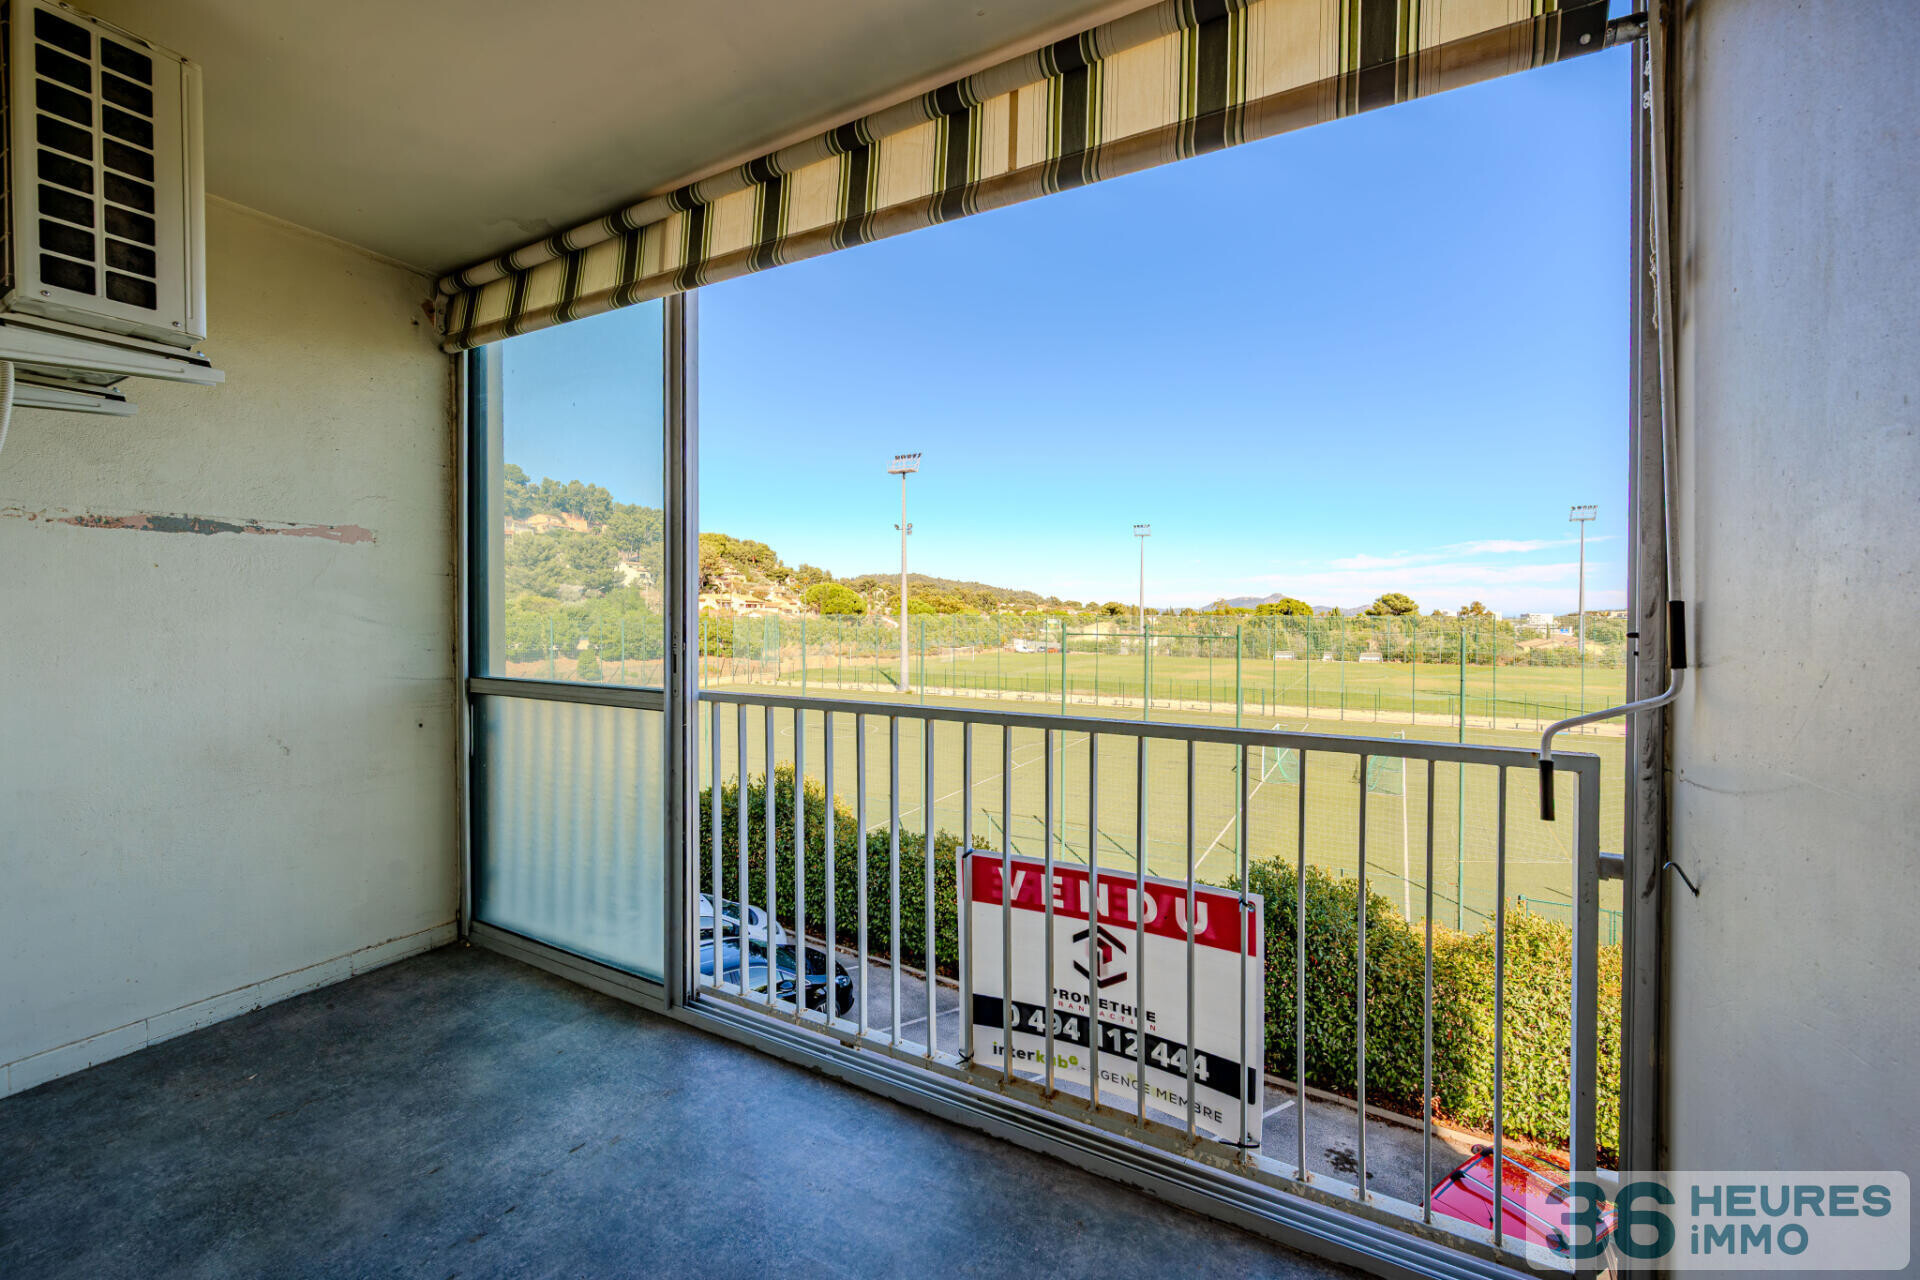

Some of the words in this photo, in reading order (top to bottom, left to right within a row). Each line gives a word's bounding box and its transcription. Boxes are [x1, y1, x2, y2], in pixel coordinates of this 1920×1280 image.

[998, 867, 1208, 935] VENDU
[1028, 1009, 1081, 1040] 494
[1150, 1042, 1210, 1081] 444
